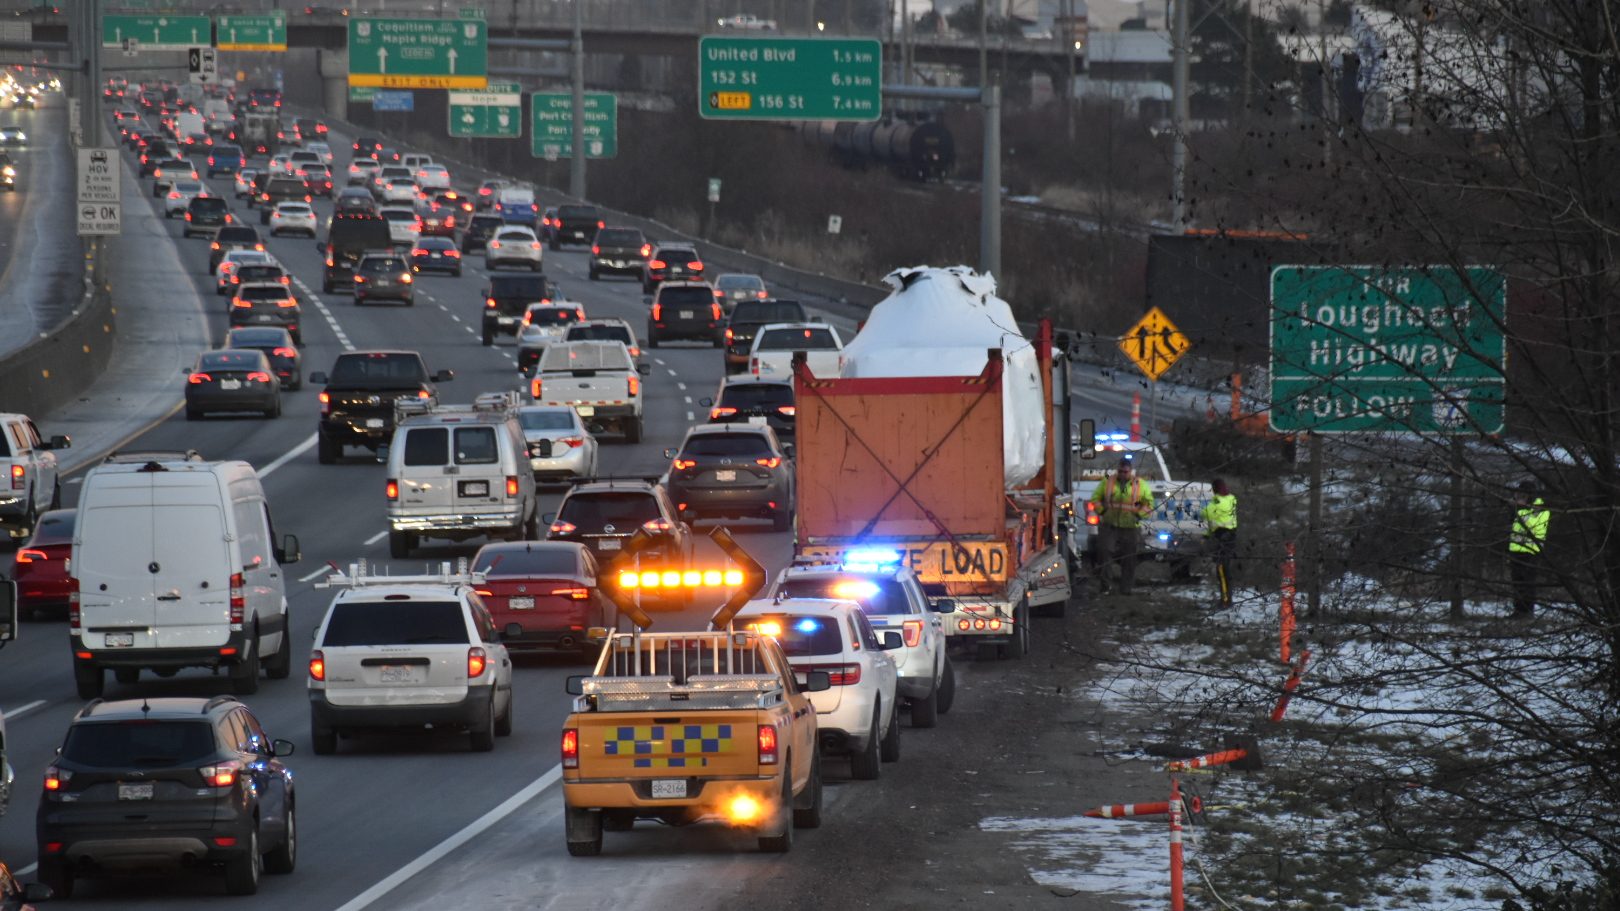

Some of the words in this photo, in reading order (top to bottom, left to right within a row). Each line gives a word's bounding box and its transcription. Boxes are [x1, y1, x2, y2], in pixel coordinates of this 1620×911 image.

[377, 22, 434, 33] Coquitlam
[383, 35, 416, 45] Maple
[421, 35, 452, 46] Ridge
[708, 48, 758, 62] United
[763, 48, 796, 62] Blvd
[833, 50, 852, 63] 1.5
[855, 51, 873, 63] km
[711, 71, 736, 84] 152
[742, 71, 758, 85] St
[832, 73, 852, 86] 6.9
[855, 74, 872, 86] km
[549, 98, 598, 109] Coqam
[720, 95, 747, 108] LEFT
[759, 95, 784, 108] 156
[789, 96, 804, 109] St
[833, 96, 852, 110] 7.4
[855, 97, 872, 110] km
[539, 111, 559, 121] Port
[89, 165, 109, 174] HOV
[100, 206, 117, 220] OK
[1301, 300, 1471, 333] Lougheed
[1310, 338, 1460, 373] Highway
[1296, 395, 1415, 418] FOLLOW
[941, 548, 1005, 576] LOAD
[653, 784, 686, 794] SR-2166
